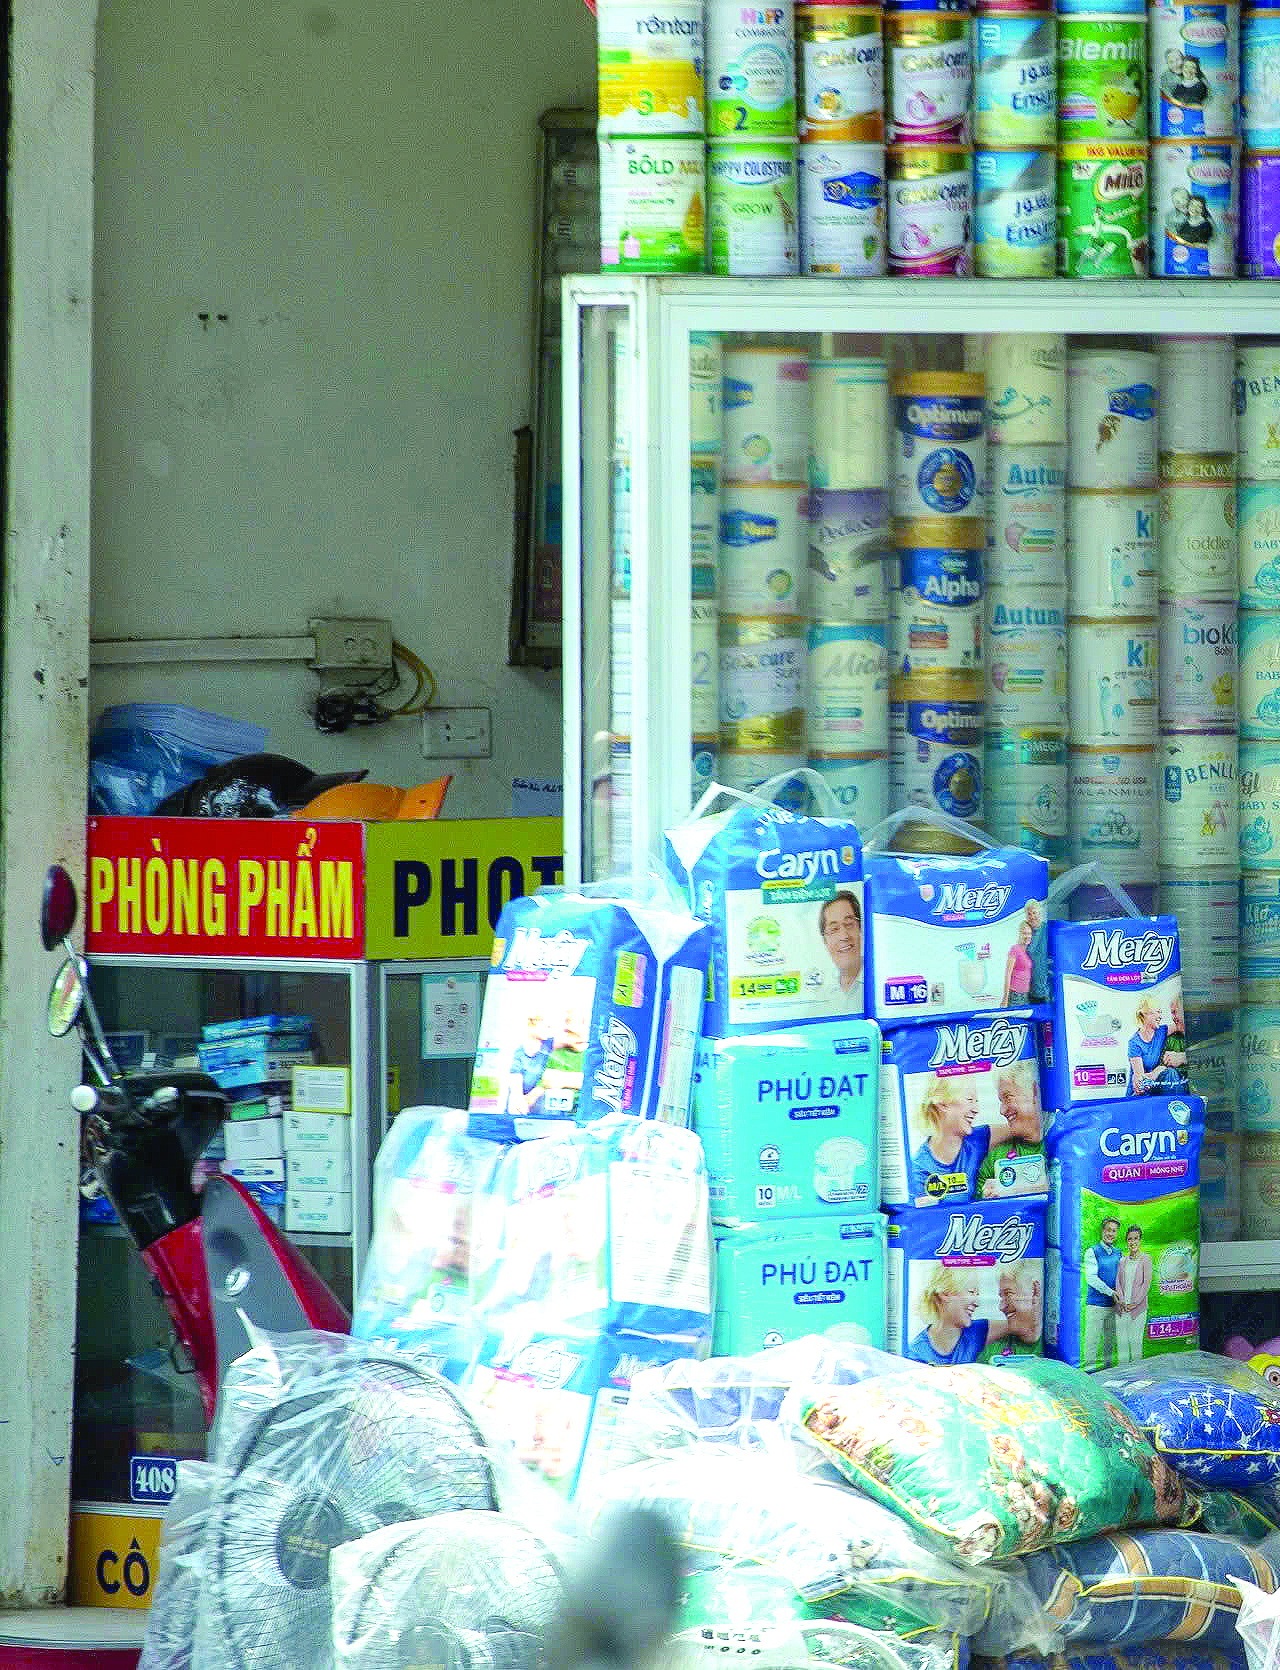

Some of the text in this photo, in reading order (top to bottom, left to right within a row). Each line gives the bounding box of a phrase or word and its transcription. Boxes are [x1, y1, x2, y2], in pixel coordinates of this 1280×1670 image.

[638, 90, 655, 116] 3
[735, 106, 748, 131] 2
[925, 577, 981, 599] Alpha
[755, 847, 839, 885] Caryn
[91, 826, 354, 939] PHÒNG PHẨM
[934, 882, 1012, 916] Merzy
[1081, 929, 1176, 976] Merzy
[890, 983, 927, 1000] M 16
[928, 1019, 1030, 1069] Merzy
[758, 1072, 870, 1103] PHÚ ĐẠT
[1099, 1127, 1177, 1164] Caryn
[758, 1187, 774, 1201] 10
[936, 1212, 1034, 1263] Merzy
[761, 1256, 874, 1287] PHÚ ĐẠT
[135, 1466, 176, 1495] 408
